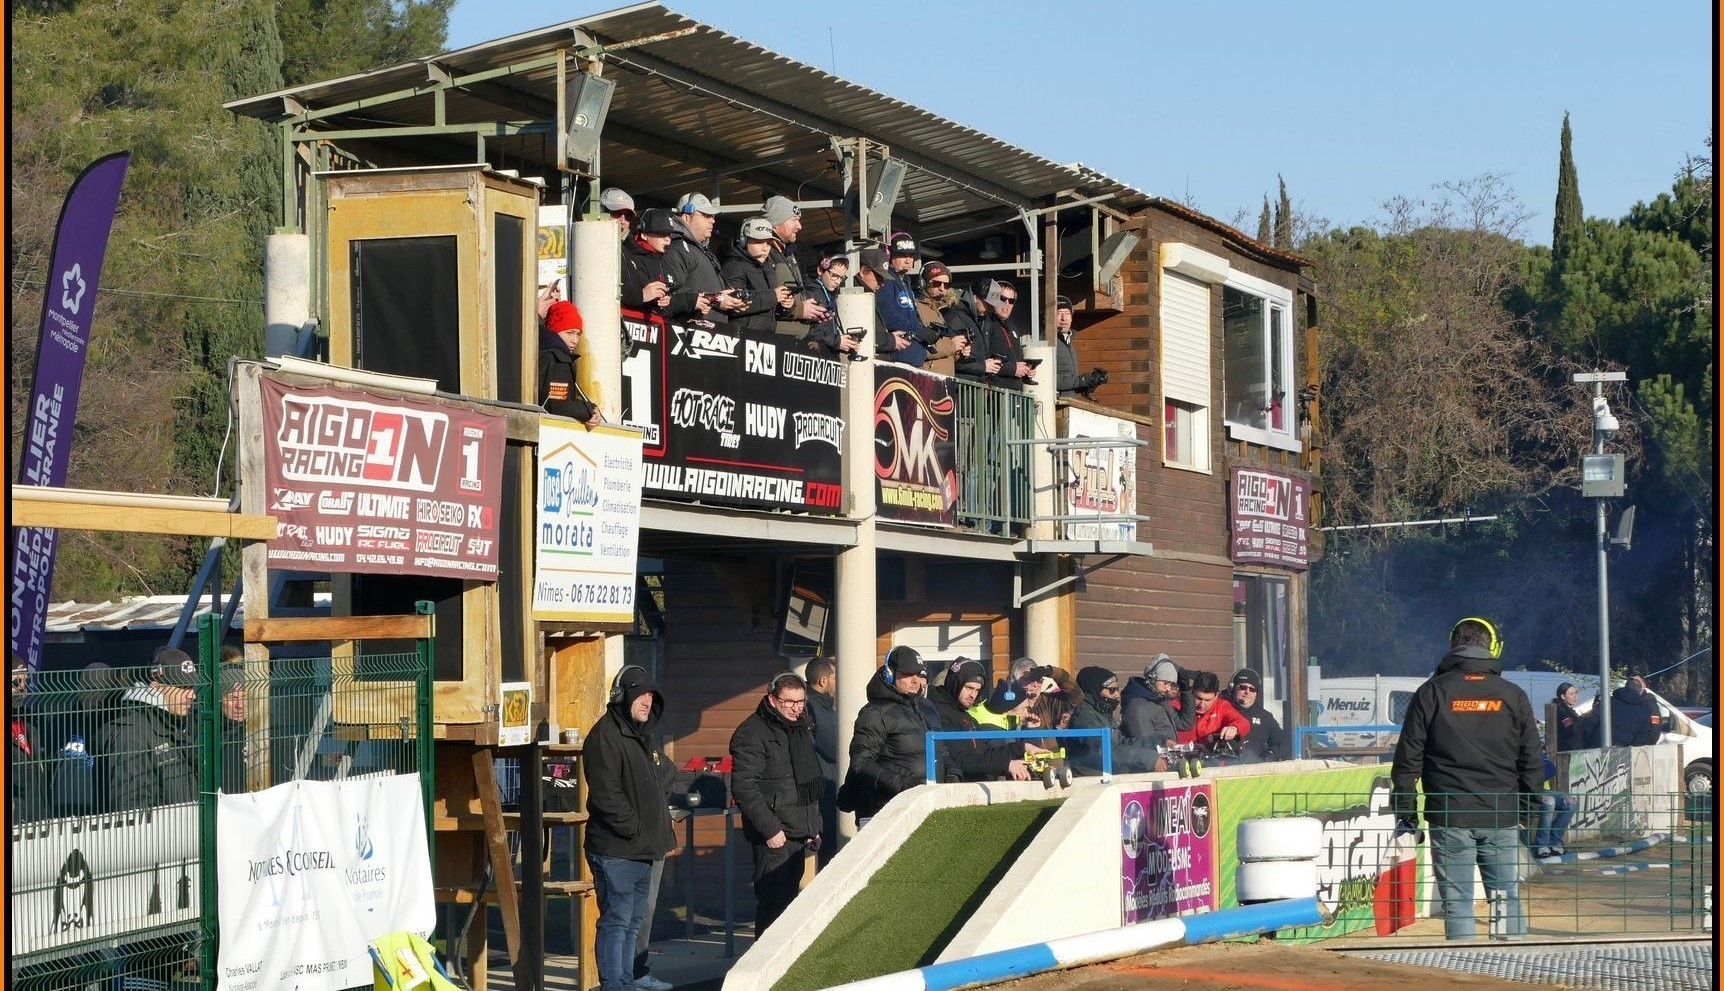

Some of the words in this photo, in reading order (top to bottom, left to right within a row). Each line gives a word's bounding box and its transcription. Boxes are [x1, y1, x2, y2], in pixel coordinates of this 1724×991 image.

[783, 351, 847, 387] ULTIMATE
[745, 402, 787, 440] HUDY
[281, 446, 364, 479] RACING
[604, 452, 633, 471] Électricité
[603, 477, 631, 494] Plomberie
[357, 492, 411, 519] ULTIMATE
[602, 500, 638, 516] Climatisation
[316, 525, 353, 546] HUDY
[542, 522, 594, 548] morata
[601, 521, 629, 538] Chauffage
[600, 543, 631, 559] Ventilation
[571, 583, 583, 604] 06
[584, 584, 595, 604] 76
[596, 585, 608, 604] 22
[609, 585, 621, 605] 81
[622, 586, 633, 605] 73
[345, 865, 386, 886] Notaires
